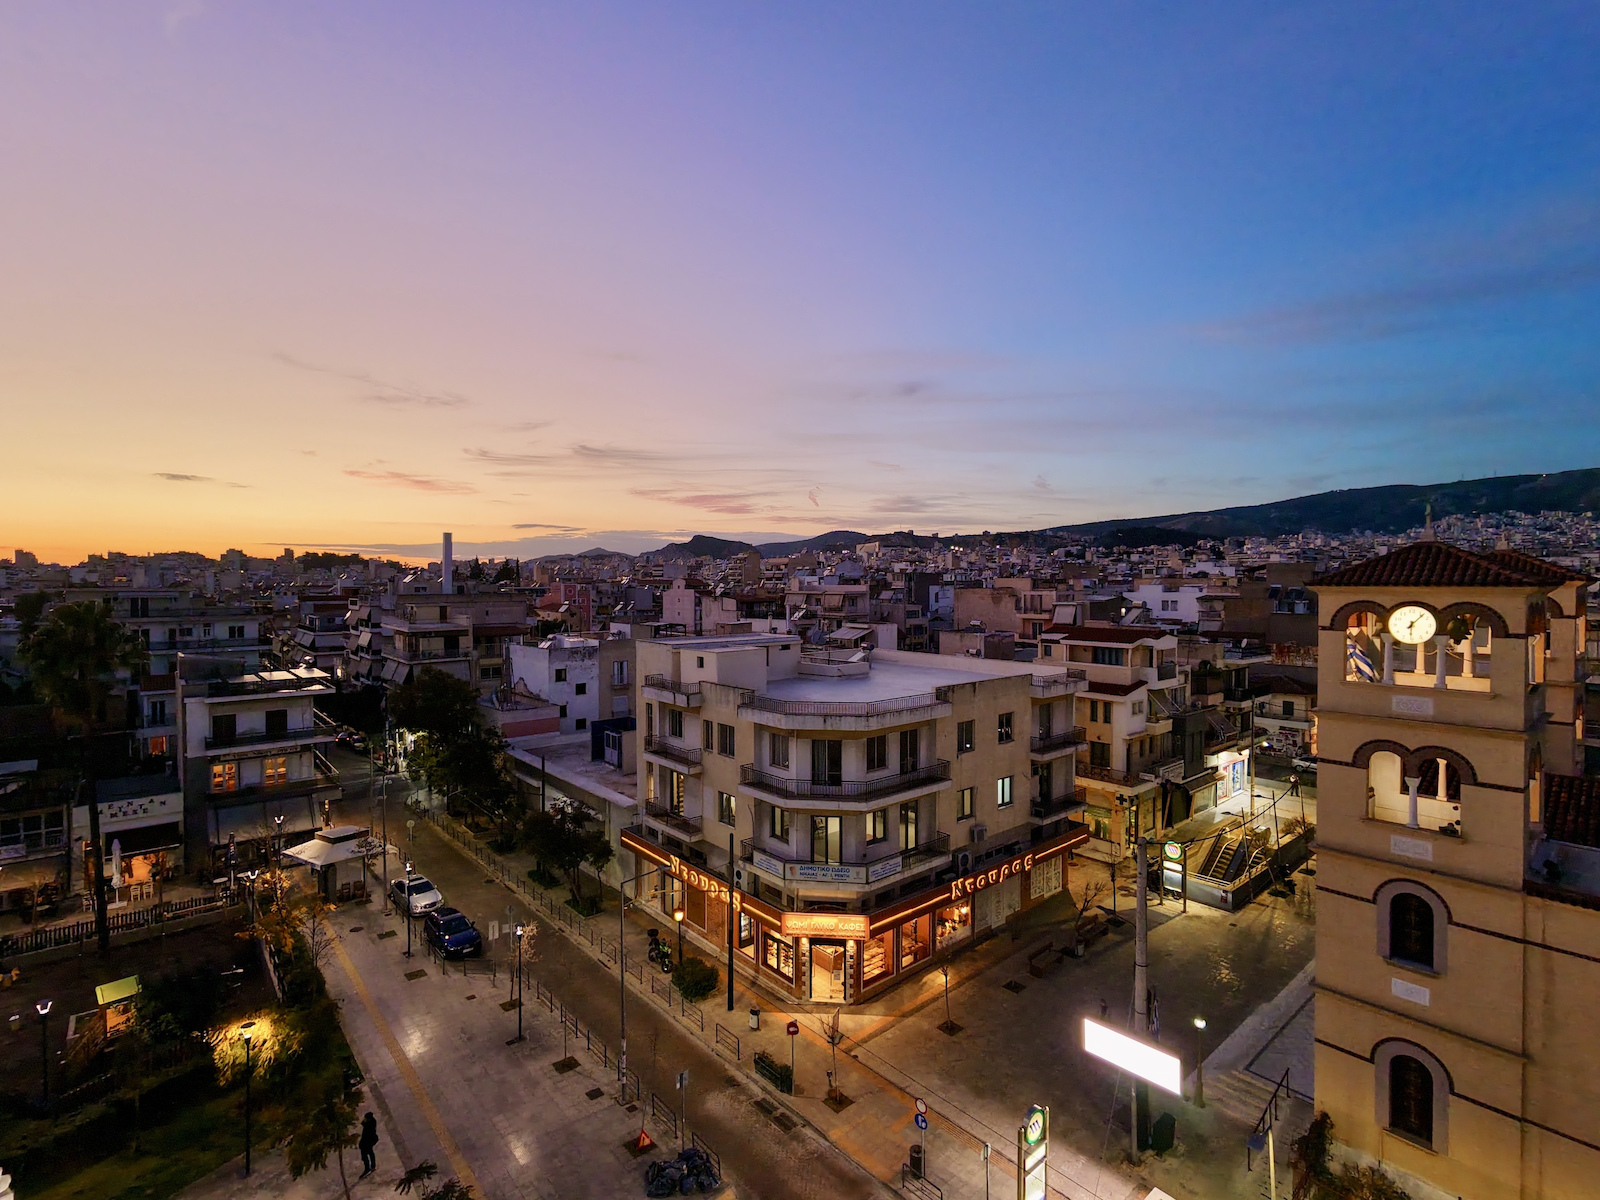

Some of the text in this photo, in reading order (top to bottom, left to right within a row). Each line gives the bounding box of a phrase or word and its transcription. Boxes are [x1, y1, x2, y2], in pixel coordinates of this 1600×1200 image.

[785, 920, 866, 931] ΨΩΜΙ ΓΛΥΚΟ ΚΑΦΕΣ
